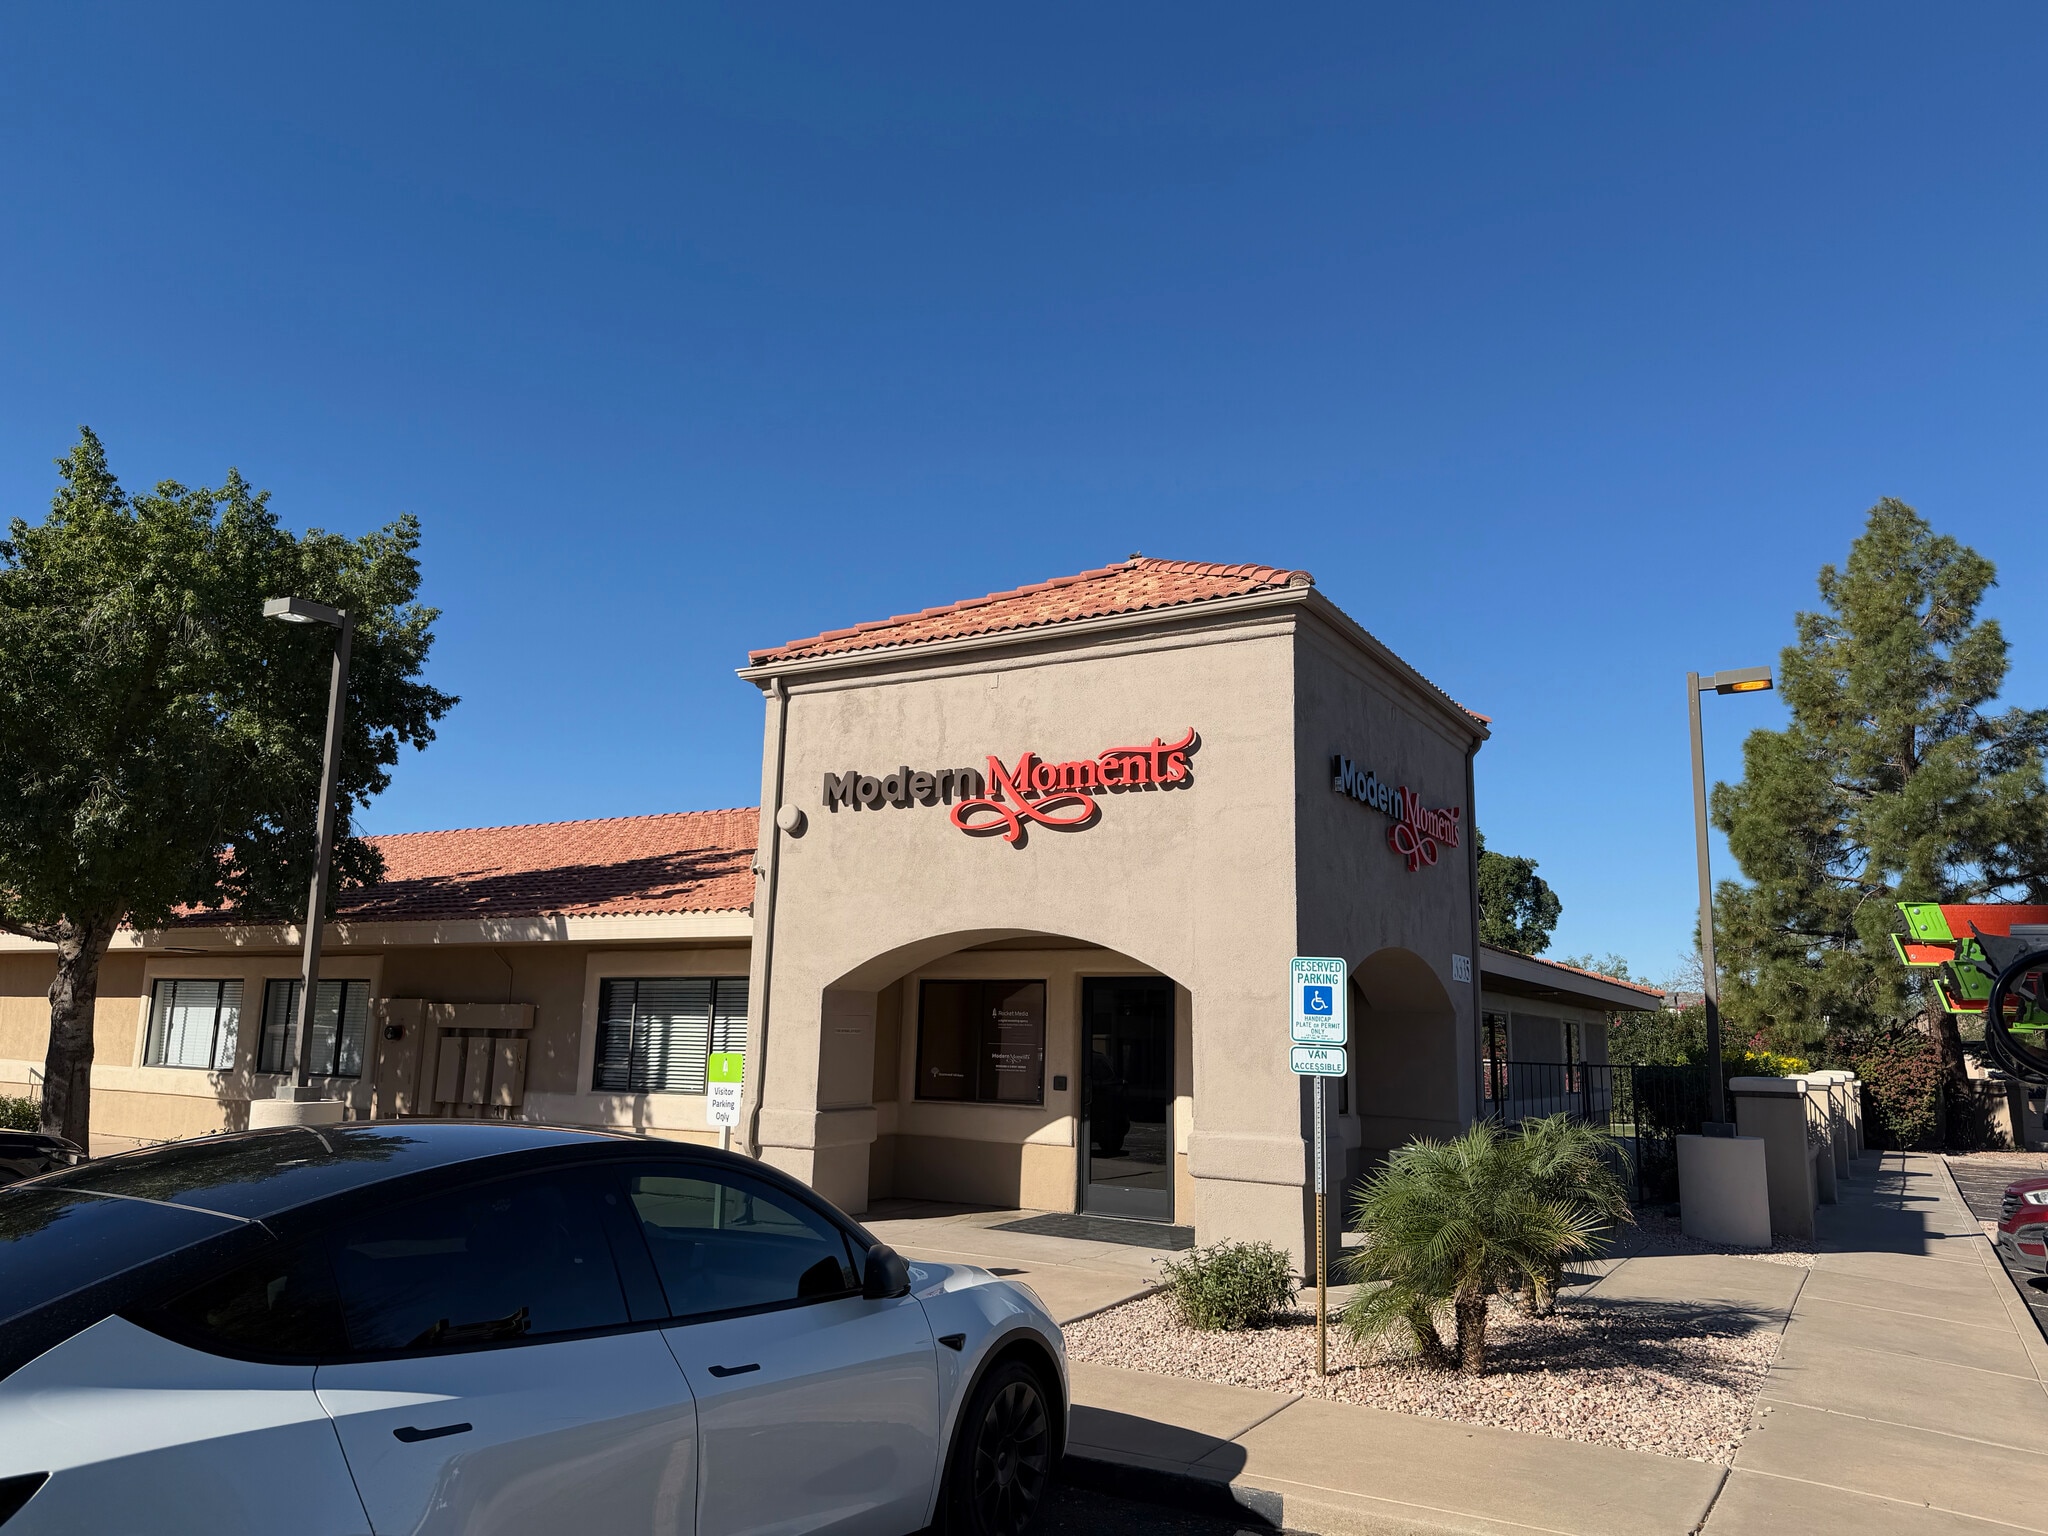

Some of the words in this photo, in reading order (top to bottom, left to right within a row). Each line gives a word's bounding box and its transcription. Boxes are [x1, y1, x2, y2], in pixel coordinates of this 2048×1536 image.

[822, 766, 981, 811] Modern
[950, 726, 1198, 843] Moments
[1337, 755, 1403, 821] Modern
[1390, 786, 1460, 872] Moments
[1294, 961, 1341, 972] RESERVED
[1297, 973, 1339, 985] PARKING
[1307, 1050, 1328, 1059] VAN
[1295, 1062, 1342, 1071] ACCESSIBLE
[714, 1087, 734, 1096] Visitor
[712, 1099, 735, 1111] Parking
[715, 1112, 730, 1122] Only
